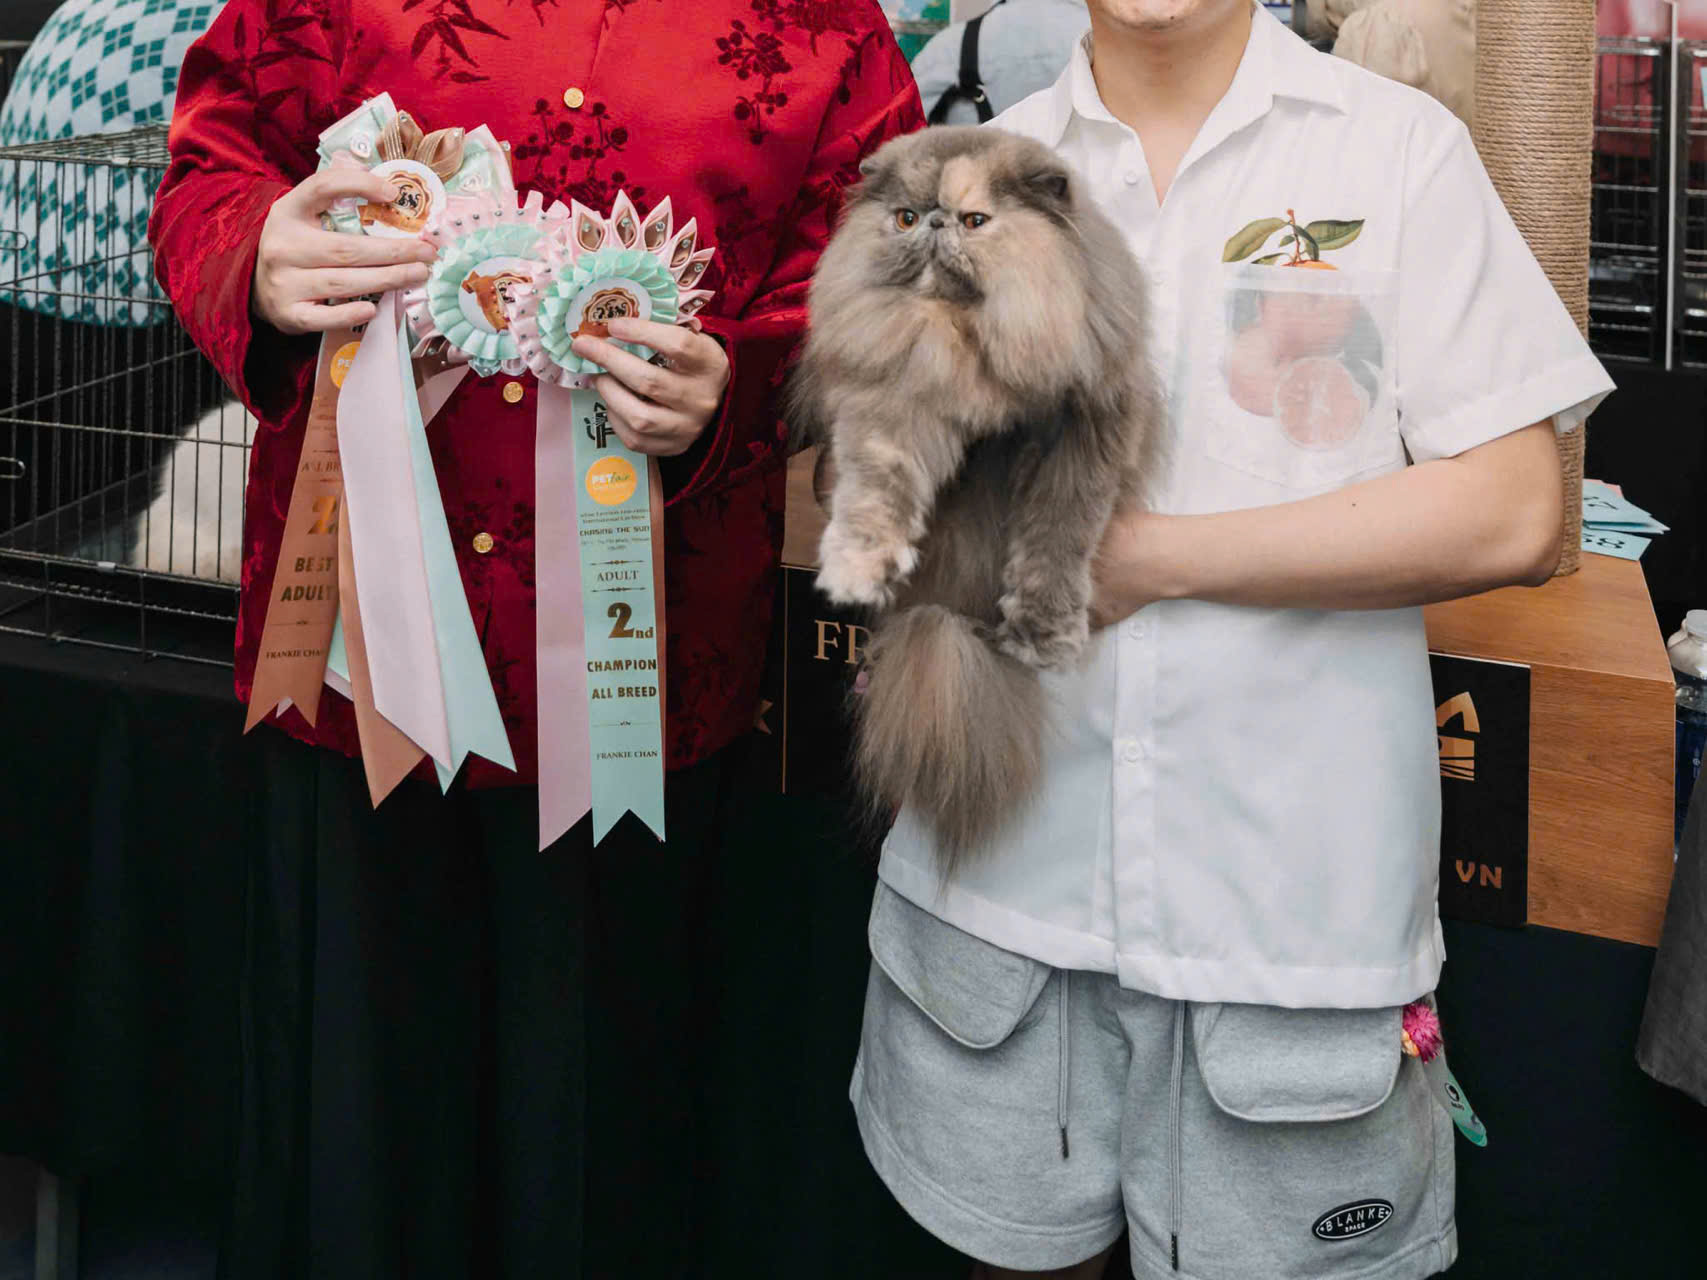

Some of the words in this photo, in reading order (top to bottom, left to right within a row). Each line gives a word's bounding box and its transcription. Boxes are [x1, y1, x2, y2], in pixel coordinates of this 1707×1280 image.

[597, 570, 640, 582] ADULT
[607, 602, 654, 639] 2nd
[587, 659, 657, 672] CHAMPION
[592, 688, 613, 700] ALL
[617, 686, 657, 698] BREED
[596, 751, 632, 760] FRANKIE
[634, 750, 657, 758] CHAN
[1455, 859, 1502, 889] VN
[1325, 1207, 1386, 1233] BLANKE
[1344, 1222, 1366, 1233] SPACE
